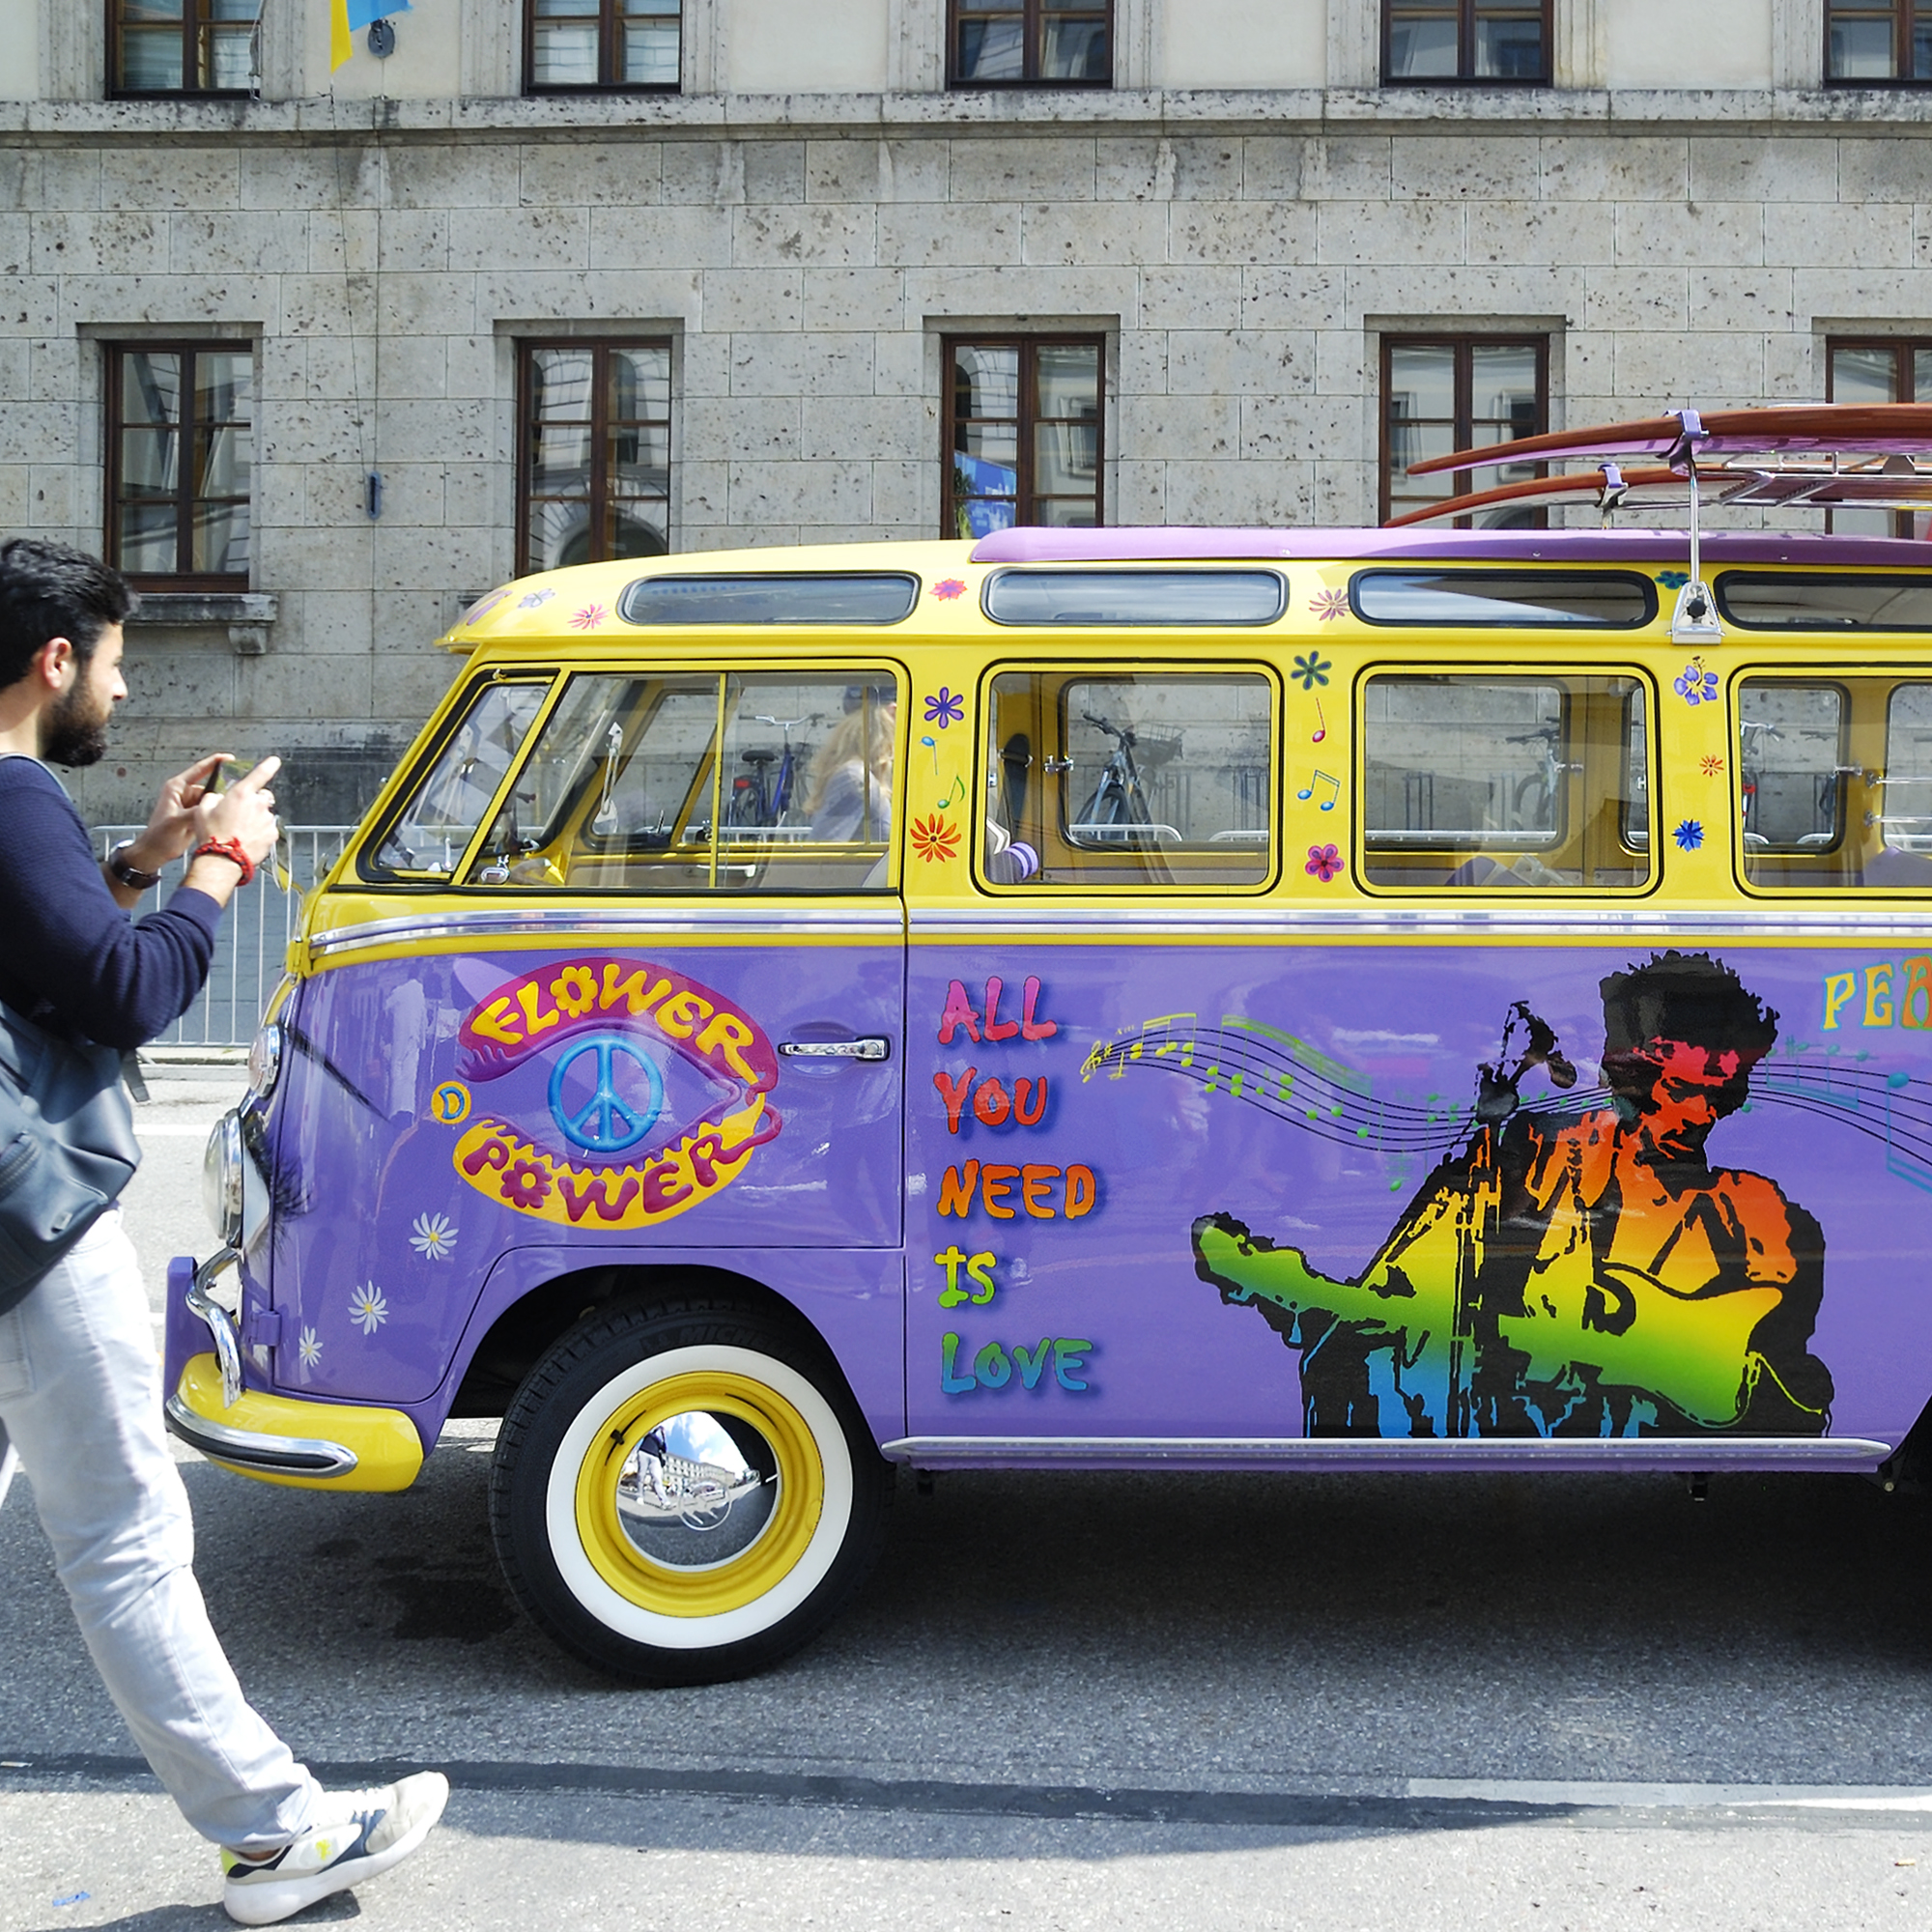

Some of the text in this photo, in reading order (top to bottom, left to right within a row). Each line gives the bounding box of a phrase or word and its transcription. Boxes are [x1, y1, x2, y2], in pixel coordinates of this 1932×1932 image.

[470, 963, 757, 1084] FLOWER
[938, 976, 1057, 1044] ALL
[1822, 953, 1932, 1031] PEA
[933, 1067, 1046, 1134] YOU
[463, 1133, 739, 1222] POWER
[937, 1159, 1096, 1219] NEED
[934, 1246, 997, 1308] IS
[941, 1332, 1093, 1394] LOVE
